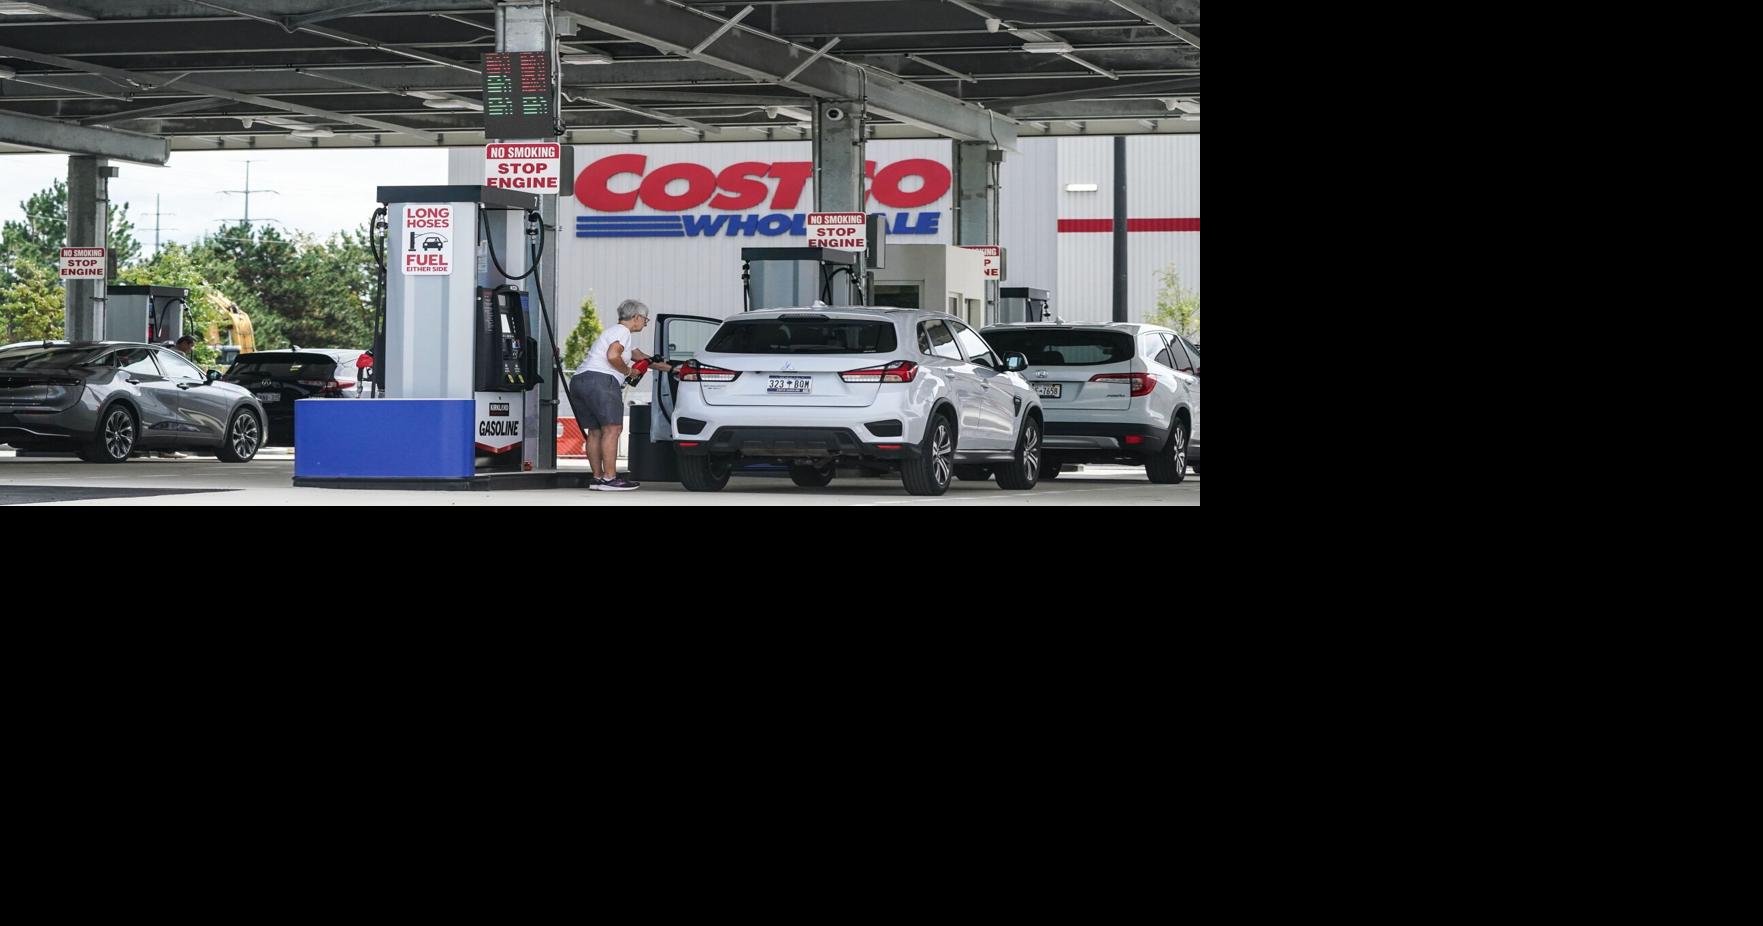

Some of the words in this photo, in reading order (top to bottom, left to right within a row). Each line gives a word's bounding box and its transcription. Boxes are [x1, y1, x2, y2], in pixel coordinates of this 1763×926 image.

[490, 147, 505, 158] NO
[508, 146, 555, 158] SMOKING
[498, 163, 548, 174] STOP
[487, 177, 558, 188] ENGINE
[574, 153, 952, 212] COSTO
[407, 208, 450, 218] LONG
[407, 219, 449, 228] HOSES
[811, 215, 822, 224] NO
[824, 215, 862, 224] SMOKING
[817, 227, 856, 236] STOP
[808, 238, 864, 247] ENGINE
[63, 249, 73, 257] NO
[73, 249, 103, 257] SMOKING
[67, 259, 98, 267] STOP
[406, 254, 449, 266] FUEL
[61, 268, 103, 276] ENGINE
[769, 379, 784, 389] 323
[479, 420, 519, 437] GASOLINE
